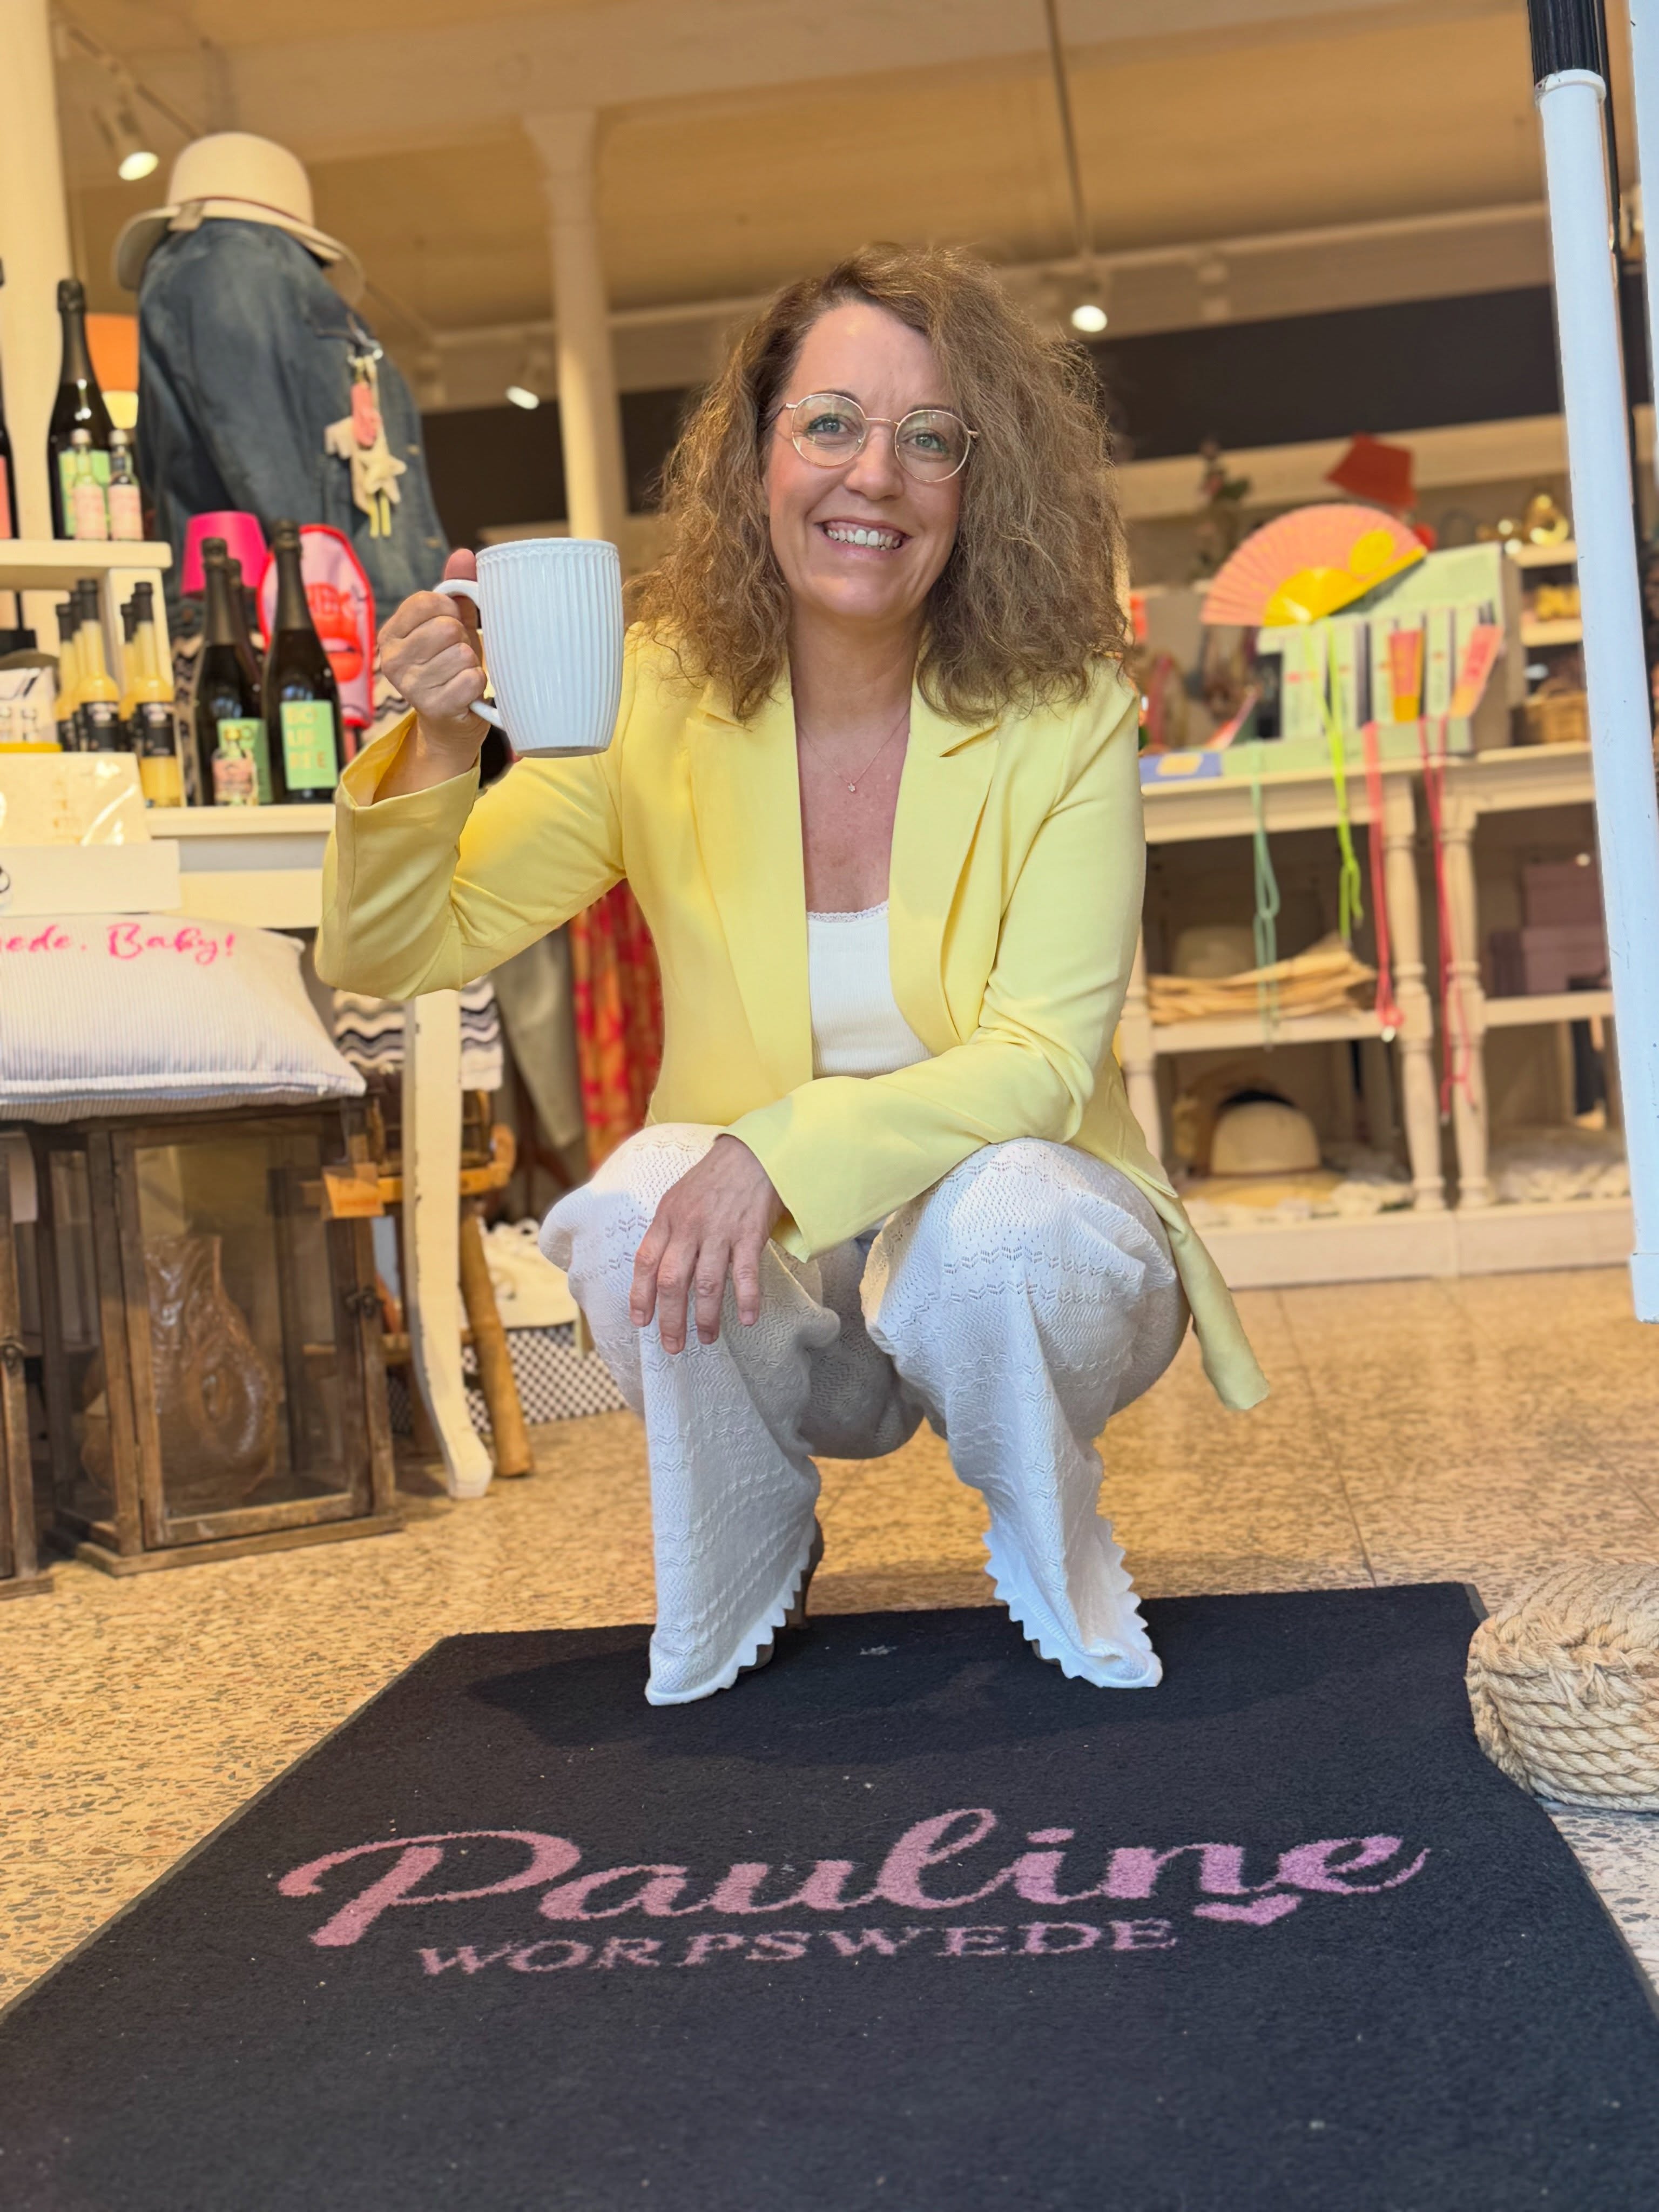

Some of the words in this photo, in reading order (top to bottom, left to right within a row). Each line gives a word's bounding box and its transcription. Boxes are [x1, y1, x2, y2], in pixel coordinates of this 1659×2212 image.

[0, 925, 87, 953] ede.
[106, 922, 235, 966] Baby!
[278, 1808, 1431, 1945] Pauline
[416, 1918, 1178, 1975] WORPSWEDE
